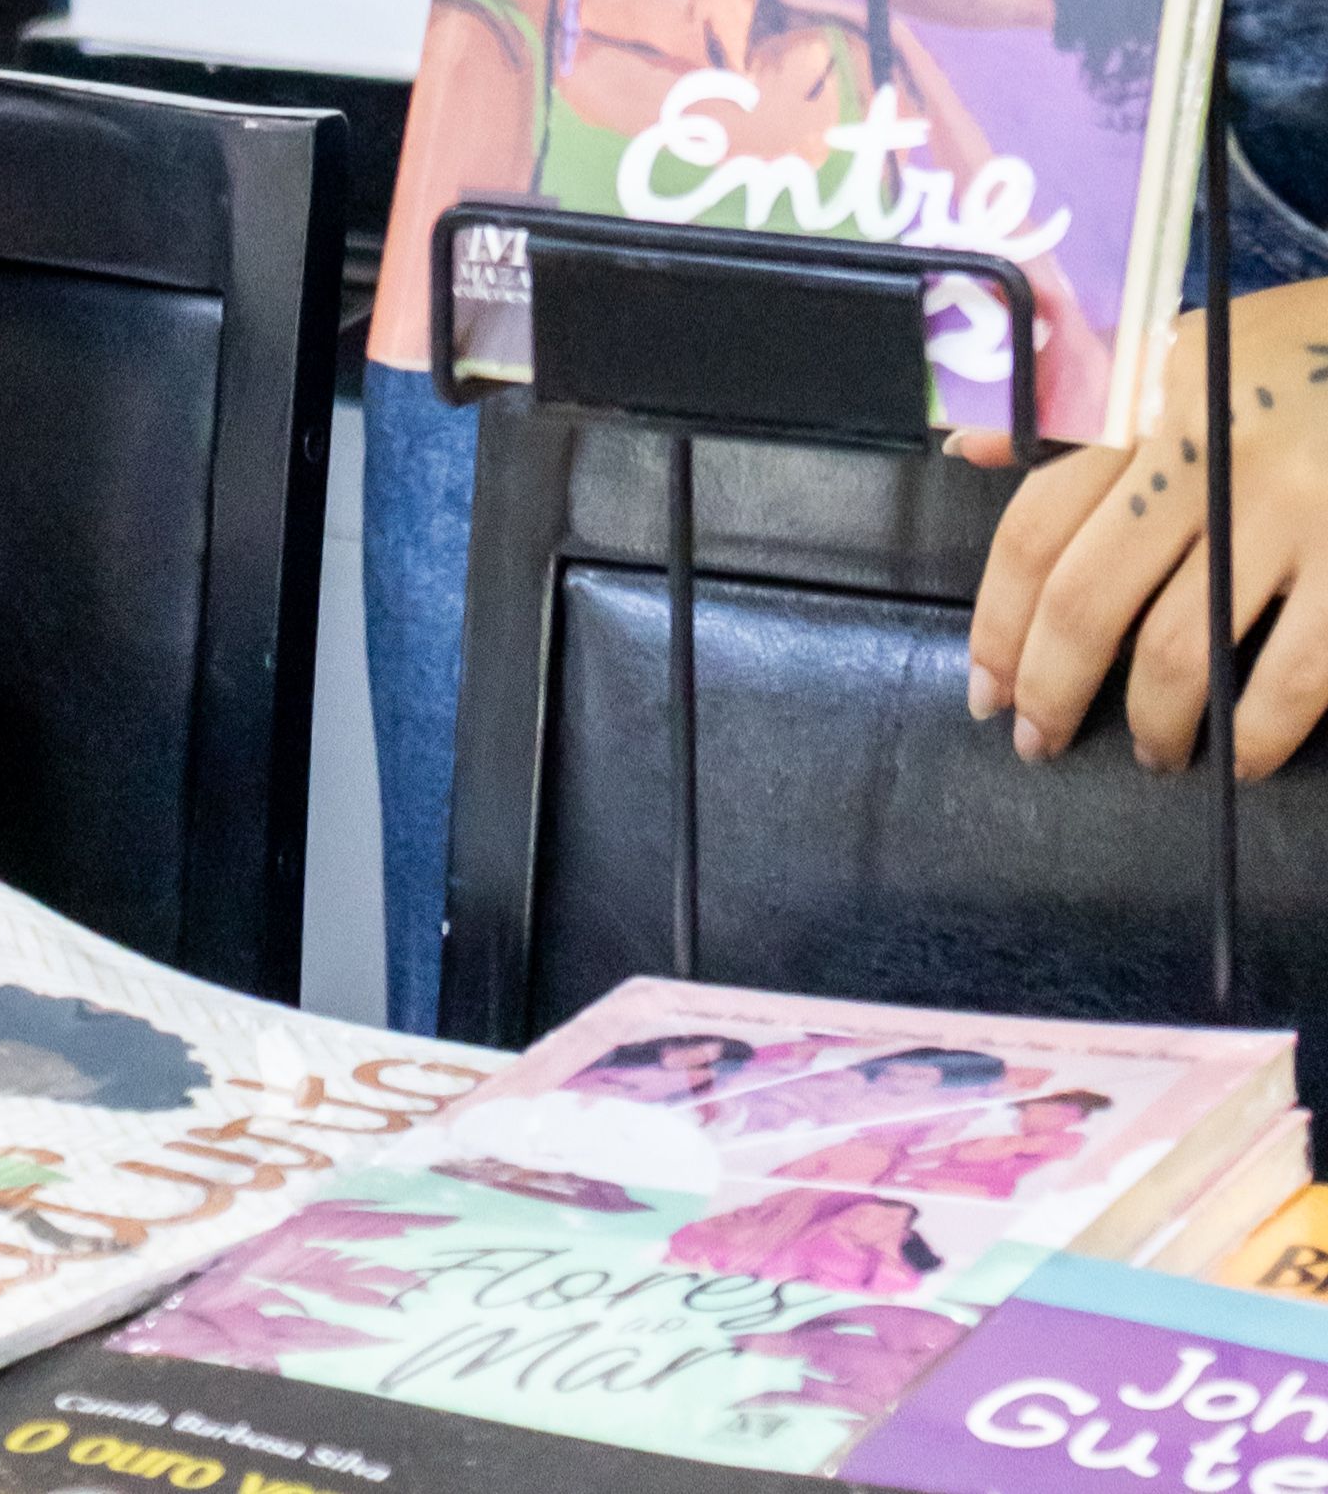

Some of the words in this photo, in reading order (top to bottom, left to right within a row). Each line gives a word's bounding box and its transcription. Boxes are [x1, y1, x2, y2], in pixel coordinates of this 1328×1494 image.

[616, 68, 1072, 263] Entre
[387, 1247, 827, 1331] Flores
[374, 1321, 744, 1393] Mar
[4, 1419, 71, 1454] O
[68, 1436, 227, 1490] ouro
